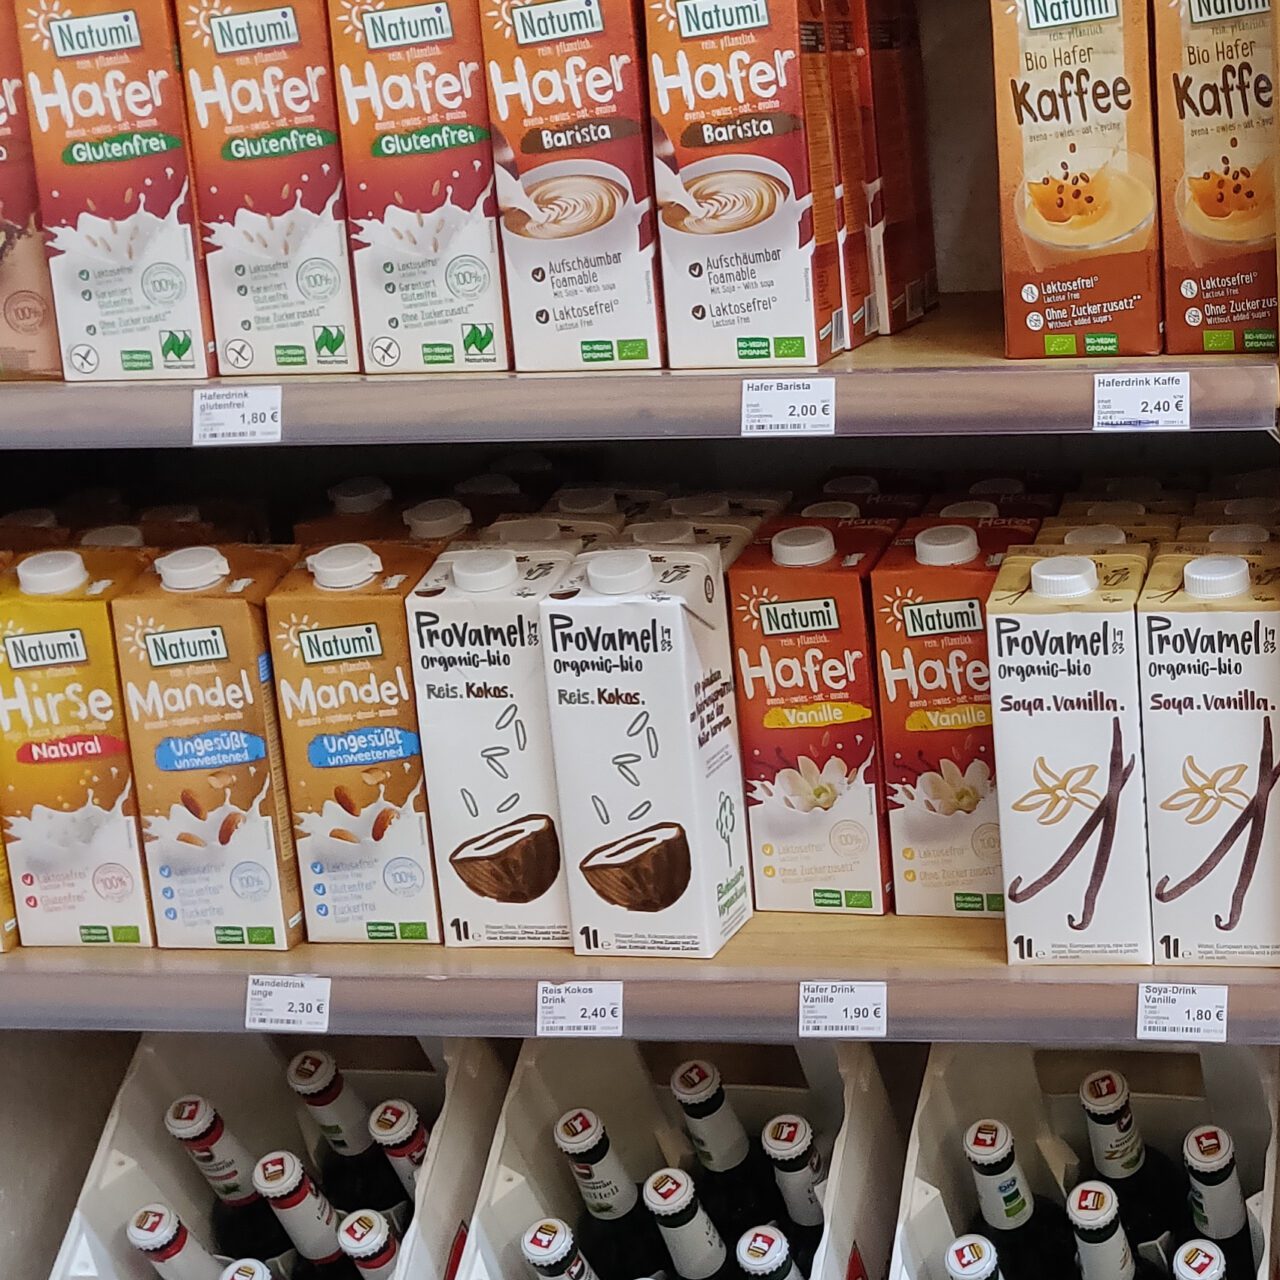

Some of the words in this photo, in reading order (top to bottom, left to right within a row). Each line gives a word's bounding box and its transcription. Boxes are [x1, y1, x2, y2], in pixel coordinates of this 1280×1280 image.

[370, 6, 444, 44] Natumi
[684, 0, 762, 32] Natumi
[57, 14, 136, 52] Natumi
[1024, 50, 1047, 71] Bio
[1054, 46, 1094, 66] Hafer
[651, 49, 795, 116] Hafer
[28, 69, 169, 132] Hafer
[339, 61, 479, 124] Hafer
[1010, 68, 1132, 124] Kaffee
[541, 126, 611, 148] Barista
[702, 119, 774, 143] Barista
[71, 135, 166, 163] Glutenfrei
[382, 128, 475, 154] Glutenfrei
[706, 249, 782, 271] Aufschäumbar
[708, 268, 756, 285] Foamable
[1045, 307, 1068, 320] Ohne
[1047, 318, 1072, 329] Without
[747, 383, 773, 391] Hafer
[776, 382, 810, 390] Barista
[1098, 378, 1150, 387] Haferdrink
[1154, 377, 1180, 386] Kaffe
[200, 391, 248, 401] Haferdrink
[200, 401, 244, 411] glutenfrei
[788, 405, 816, 417] 2,00
[822, 404, 830, 415] €
[1141, 400, 1170, 414] 2,40
[1175, 400, 1184, 412] €
[240, 412, 267, 425] 1,80
[765, 601, 834, 631] Natumi
[549, 614, 658, 653] Provamel
[996, 617, 1109, 658] Provamel
[11, 632, 80, 663] Natumi
[306, 627, 375, 661] Natumi
[738, 646, 864, 700] Hafer
[280, 667, 410, 720] Mandel
[0, 675, 115, 732] Hirse
[784, 707, 843, 725] Vanille
[31, 736, 102, 761] Natural
[324, 729, 402, 753] Ungesüßt
[328, 747, 404, 766] unsweetened
[251, 989, 273, 998] unge
[252, 979, 306, 989] Mandeldrink
[542, 986, 562, 995] Reis
[565, 986, 593, 995] Kokos
[803, 986, 826, 994] Hafer
[830, 986, 855, 994] Drink
[1145, 986, 1197, 995] Soya-Drink
[288, 1002, 313, 1015] 2,30
[542, 996, 565, 1005] Drink
[803, 995, 834, 1004] Vanille
[1145, 995, 1176, 1005] Vanille
[580, 1007, 606, 1020] 2,40
[842, 1007, 869, 1020] 1,90
[1184, 1009, 1212, 1022] 1,80
